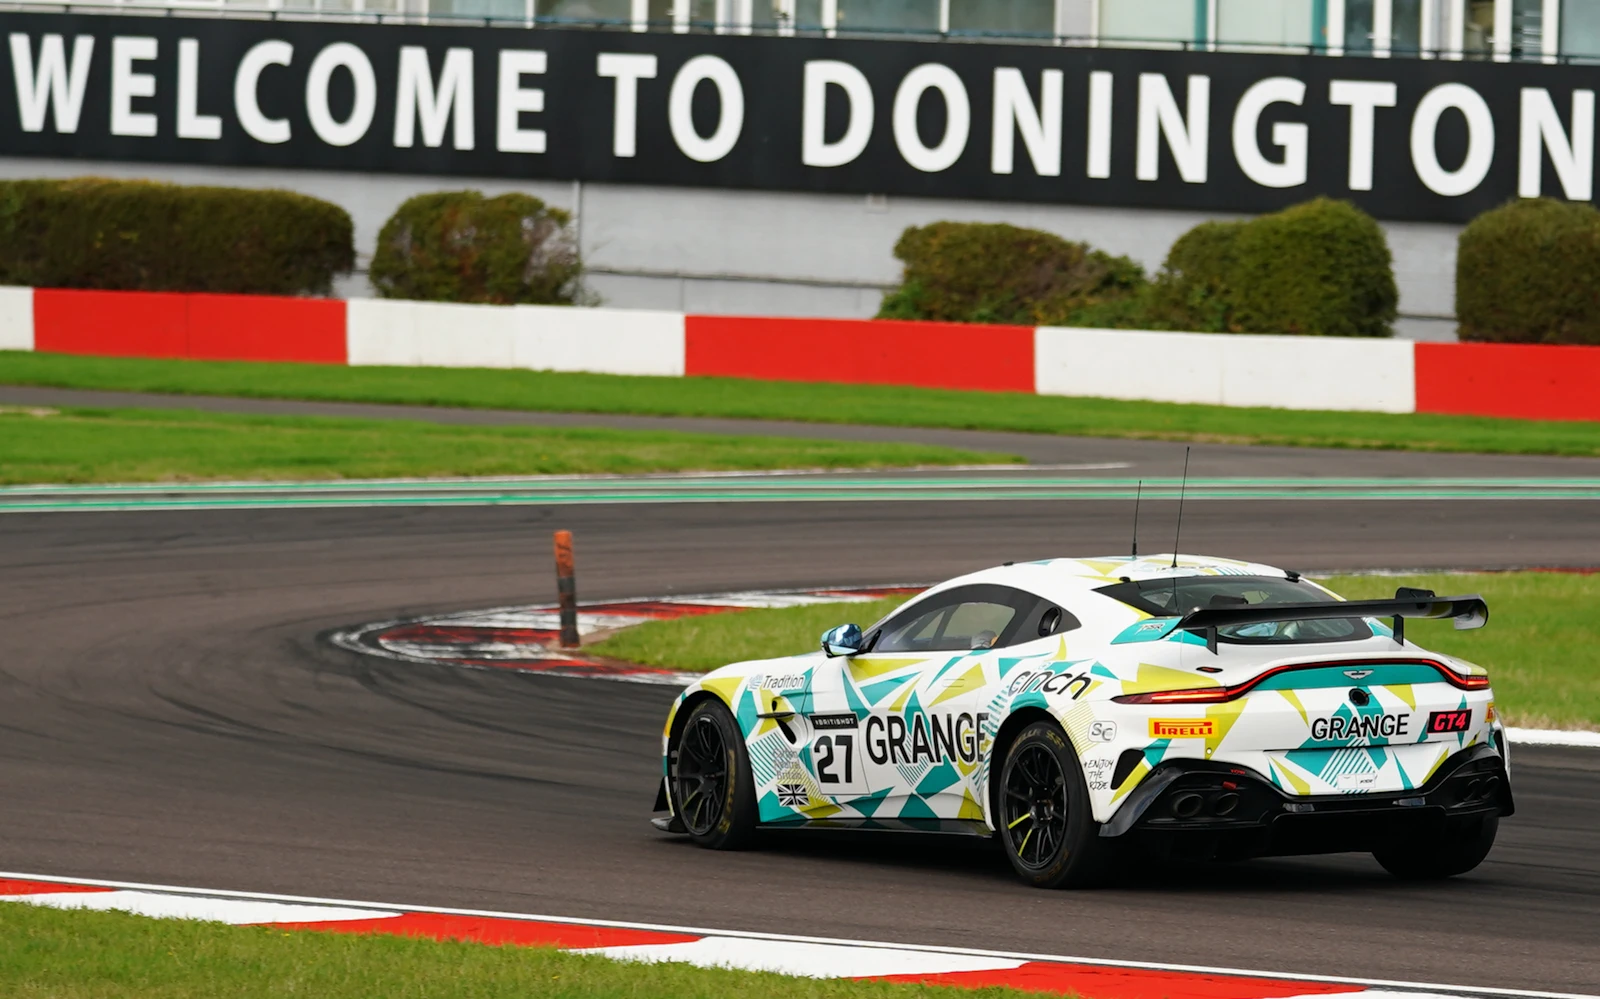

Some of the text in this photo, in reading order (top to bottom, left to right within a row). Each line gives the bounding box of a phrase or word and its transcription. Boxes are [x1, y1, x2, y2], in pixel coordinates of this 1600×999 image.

[9, 33, 1596, 201] WELCOME TO DONINGTON
[763, 674, 804, 688] Tradition
[1008, 671, 1092, 700] cinch
[1154, 721, 1213, 735] PIRELLI
[1311, 713, 1410, 740] GRANGE
[1433, 712, 1467, 731] GT4
[866, 712, 990, 765] GRANGE
[814, 735, 853, 784] 27
[1089, 770, 1104, 782] THE
